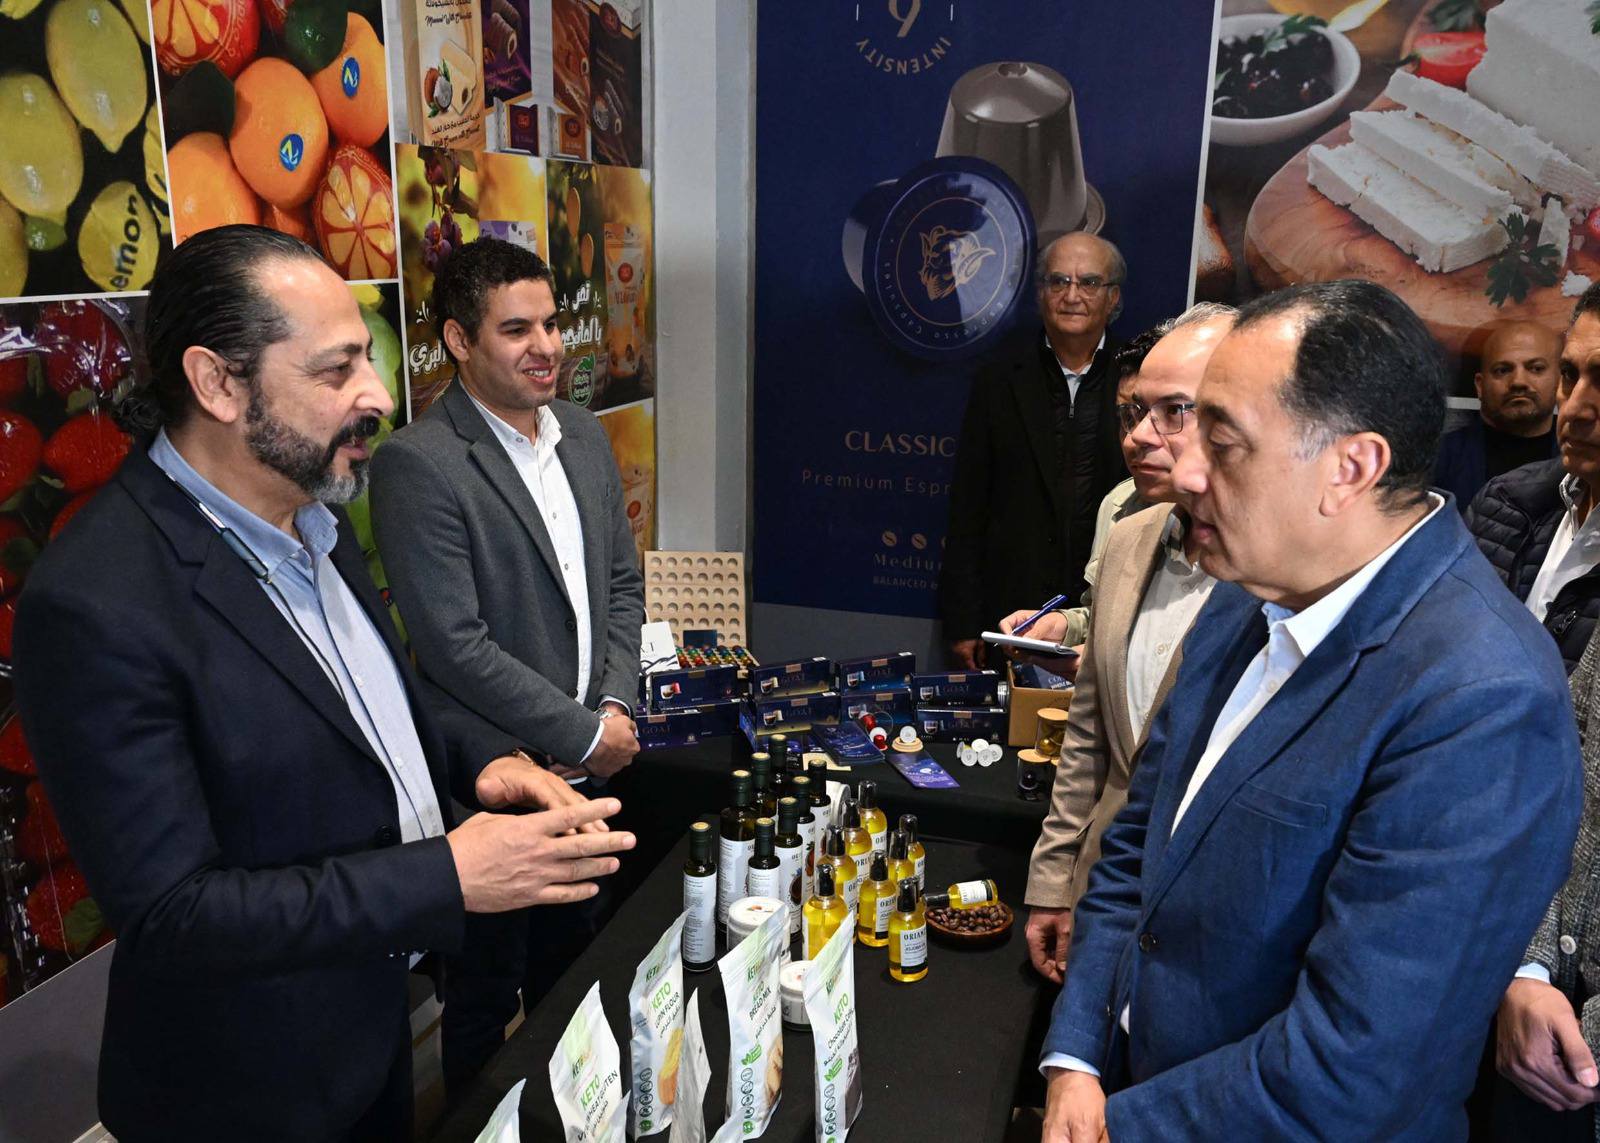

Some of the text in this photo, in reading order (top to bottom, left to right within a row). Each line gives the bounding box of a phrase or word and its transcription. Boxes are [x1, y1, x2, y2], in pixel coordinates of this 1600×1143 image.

[855, 36, 952, 76] INTENSITY
[844, 430, 957, 457] CLASSIC
[801, 468, 894, 491] Premium
[651, 982, 671, 1010] KETO
[665, 991, 681, 1010] FLOUR
[833, 992, 850, 1024] KETO
[580, 1073, 601, 1111] KETO
